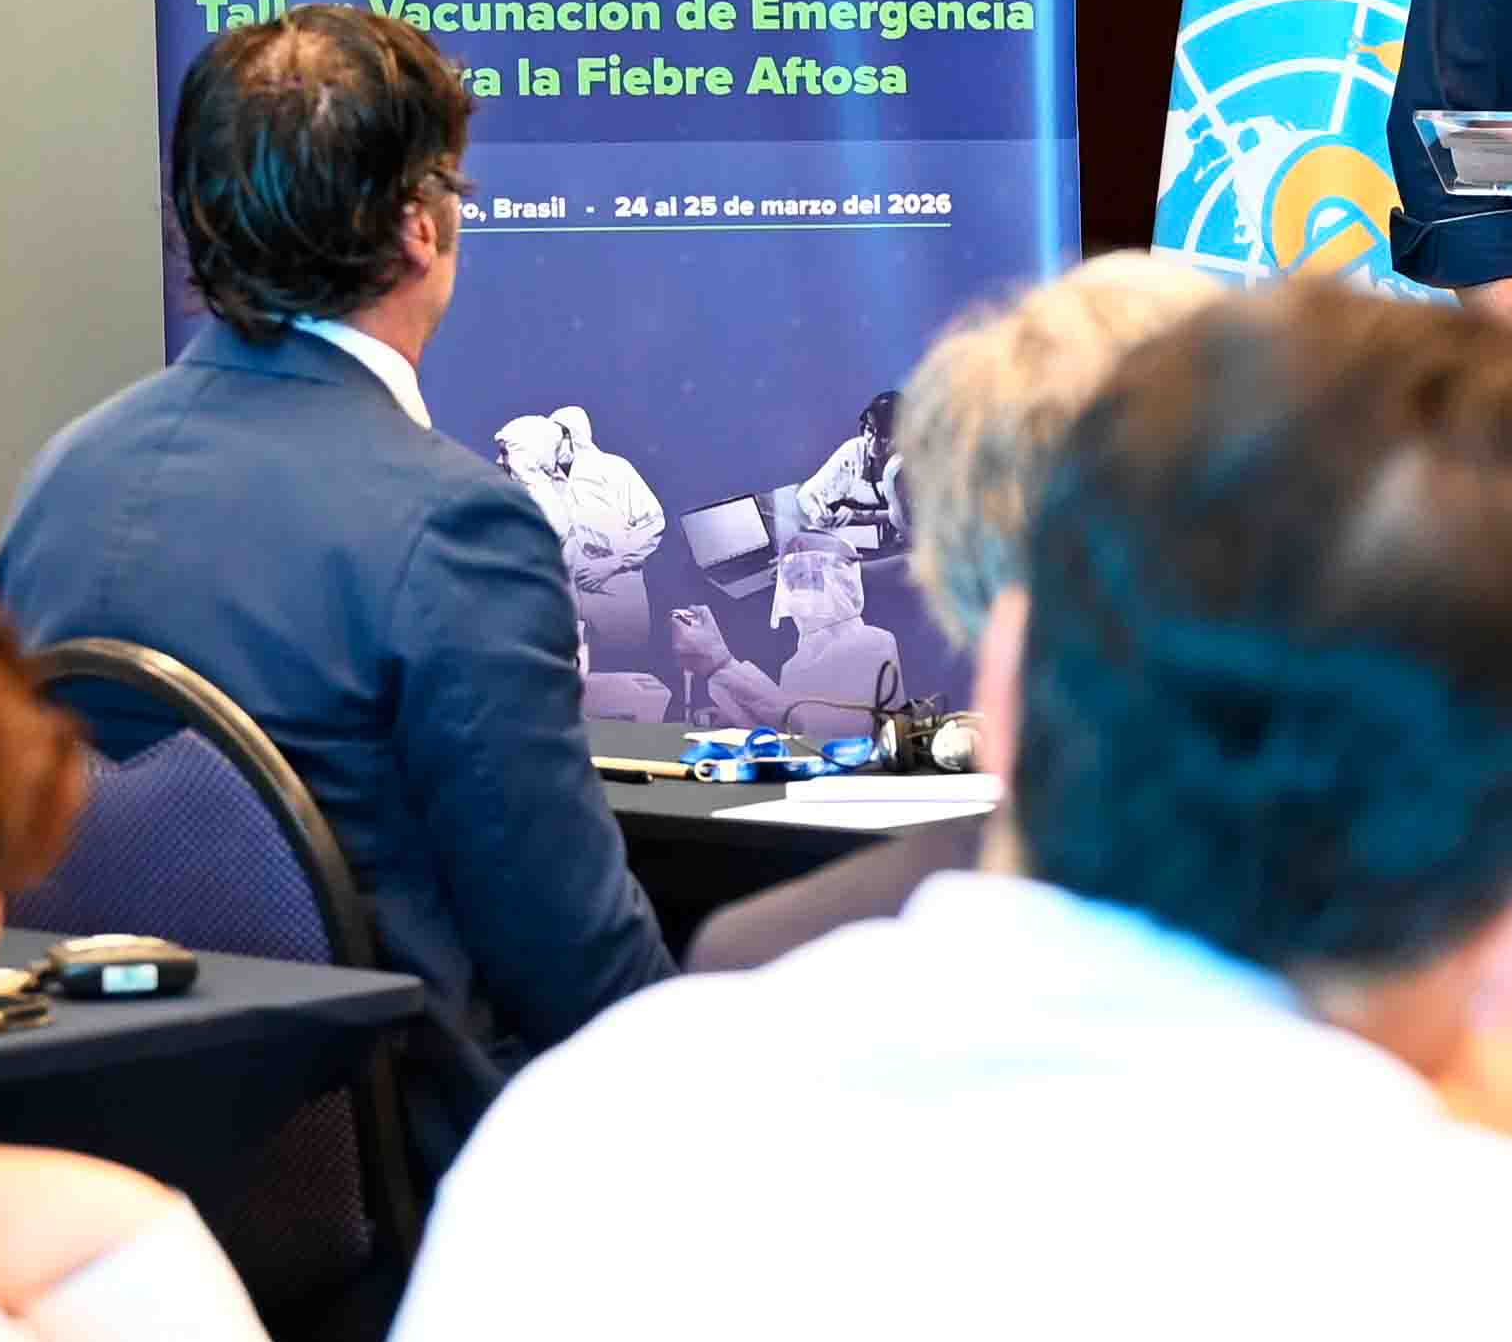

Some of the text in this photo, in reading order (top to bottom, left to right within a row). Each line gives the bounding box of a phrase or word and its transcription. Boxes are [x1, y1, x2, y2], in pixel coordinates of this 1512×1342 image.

[518, 58, 561, 96] la
[578, 53, 734, 96] Fiebre
[747, 55, 908, 95] Aftosa
[493, 196, 566, 219] Brasil
[615, 196, 649, 218] 24
[654, 196, 678, 217] al
[683, 195, 718, 217] 25
[723, 195, 755, 216] de
[760, 198, 837, 216] marzo
[842, 194, 881, 215] del
[887, 193, 952, 215] 2026
